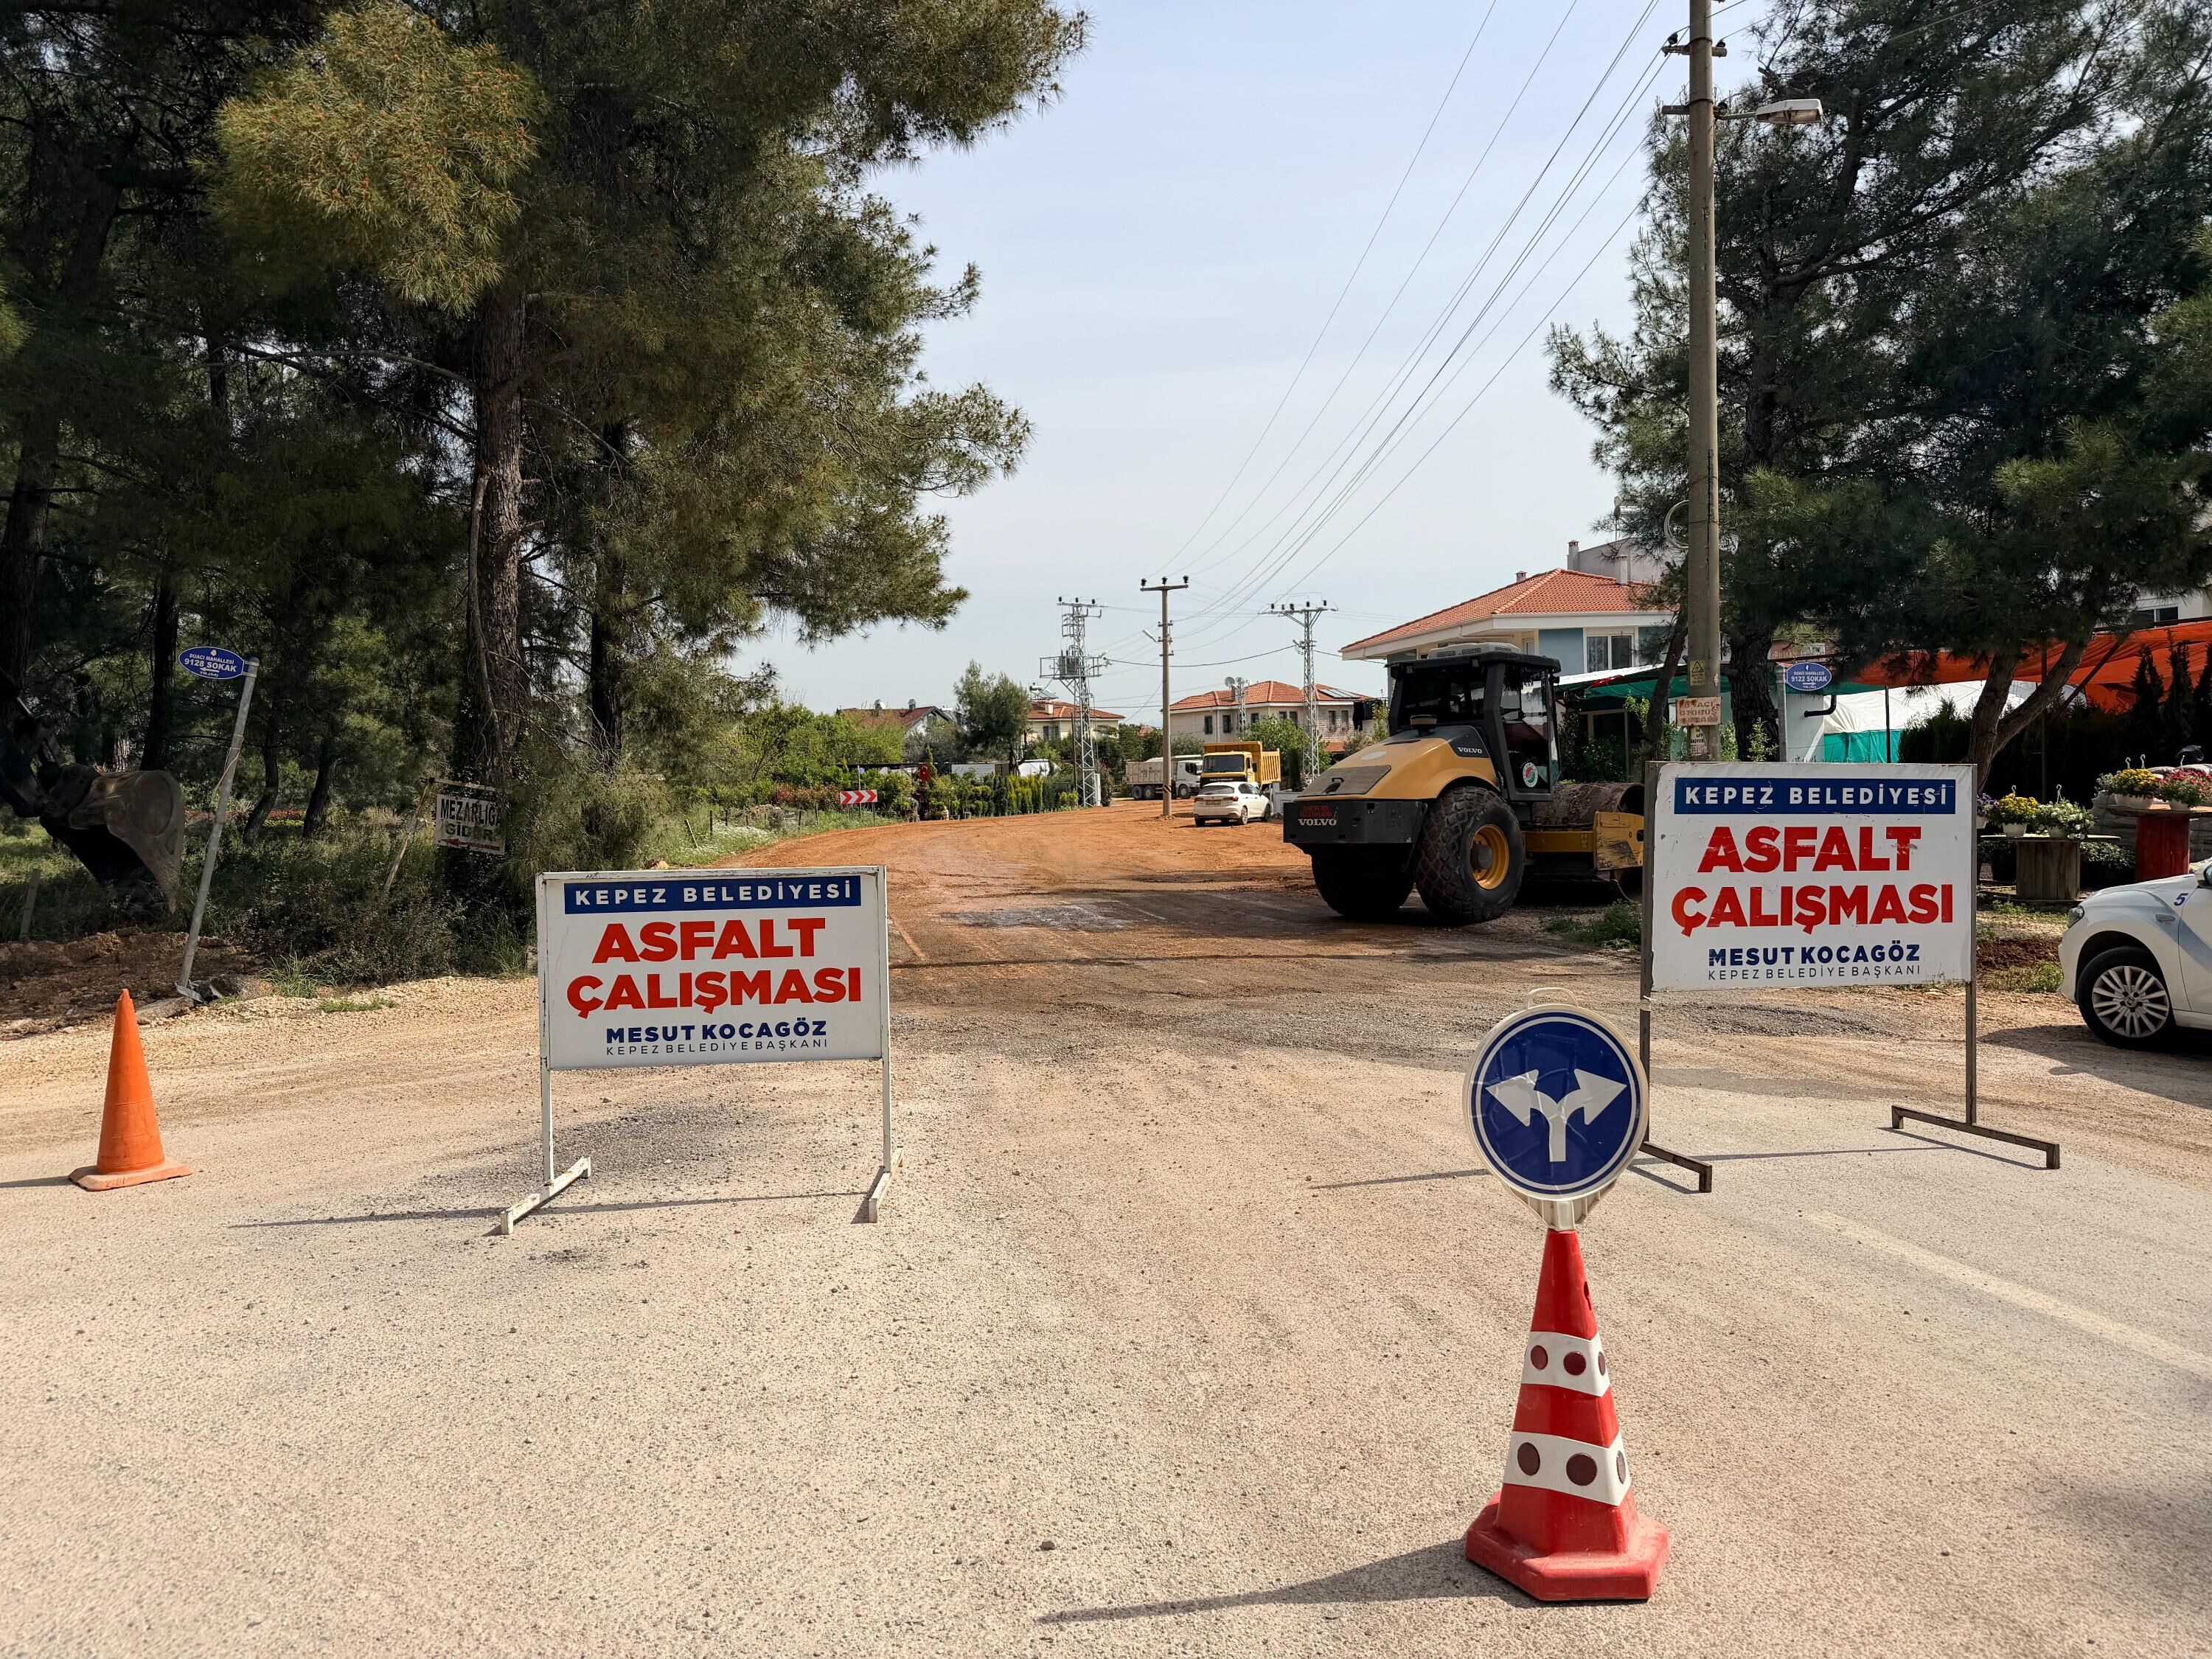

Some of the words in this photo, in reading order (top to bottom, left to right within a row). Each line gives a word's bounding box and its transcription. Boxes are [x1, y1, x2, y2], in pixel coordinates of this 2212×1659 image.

[184, 658, 205, 667] 9128
[206, 662, 237, 672] SOKAK
[1686, 787, 1773, 804] KEPEZ
[1790, 783, 1947, 804] BELEDİYESİ
[1697, 826, 1921, 873] ASFALT
[575, 888, 667, 905] KEPEZ
[683, 880, 850, 902] BELEDİYESİ
[2174, 892, 2189, 906] 5
[1672, 884, 1953, 937] ÇALIŞMASI
[592, 917, 826, 964] ASFALT
[1708, 947, 1795, 966] MESUT
[1801, 940, 1920, 964] KOCAGÖZ
[1708, 970, 1759, 980] KEPEZ
[1766, 965, 1845, 979] BELEDİYE
[1851, 964, 1920, 978] BAŞKANI
[566, 967, 861, 1019] ÇALIŞMASI
[606, 1026, 695, 1043] MESUT
[702, 1018, 827, 1040] KOCAGÖZ
[606, 1045, 659, 1056] KEPEZ
[666, 1040, 748, 1053] BELEDİYE
[755, 1038, 827, 1051] BAŞKANI
